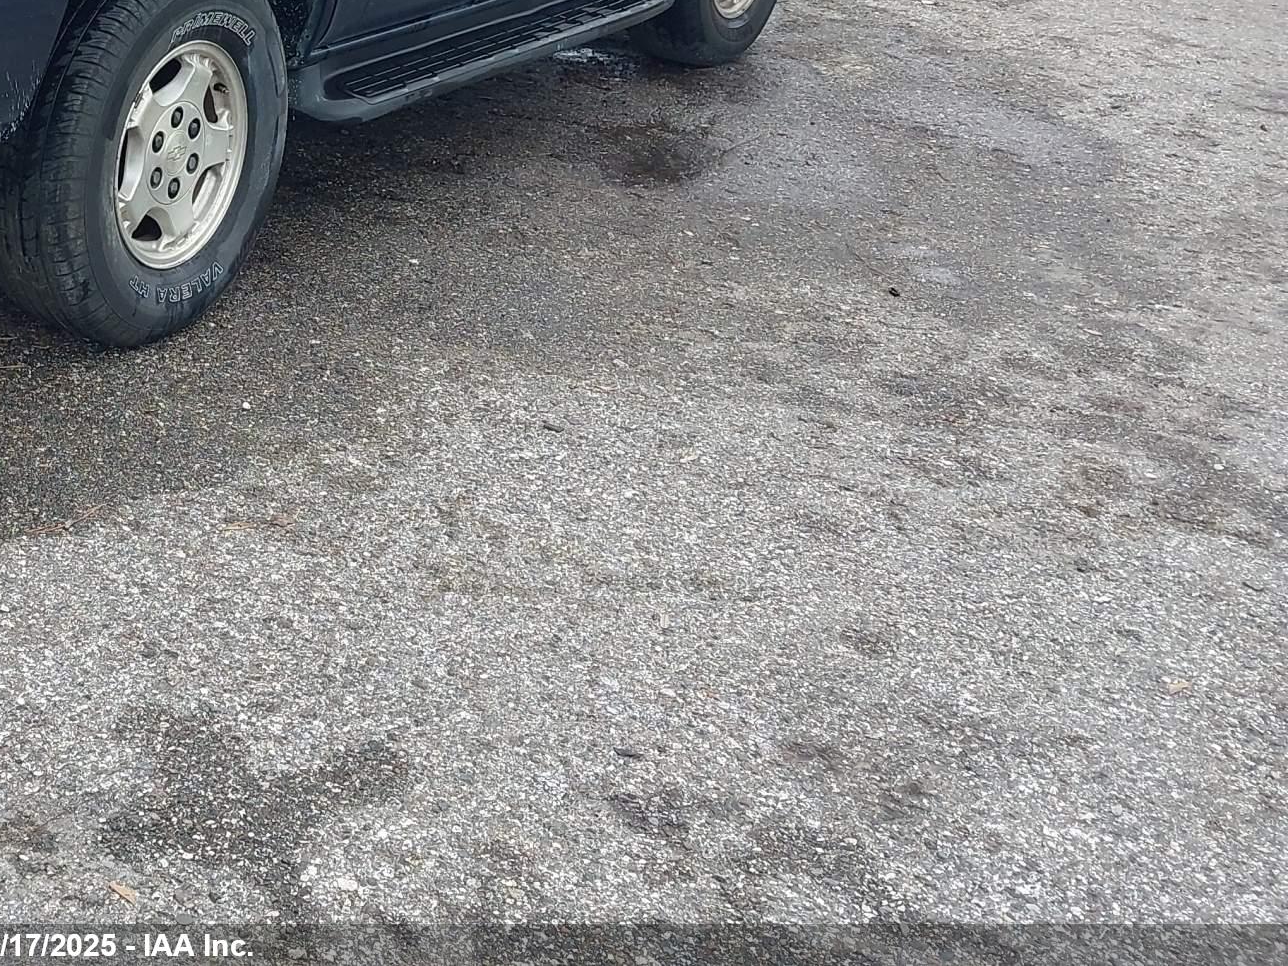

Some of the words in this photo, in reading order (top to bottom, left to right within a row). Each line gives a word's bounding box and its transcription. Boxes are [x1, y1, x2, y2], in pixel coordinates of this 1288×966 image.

[168, 12, 256, 49] PRIMEWELL
[129, 275, 150, 298] HT
[157, 262, 223, 303] VALERA
